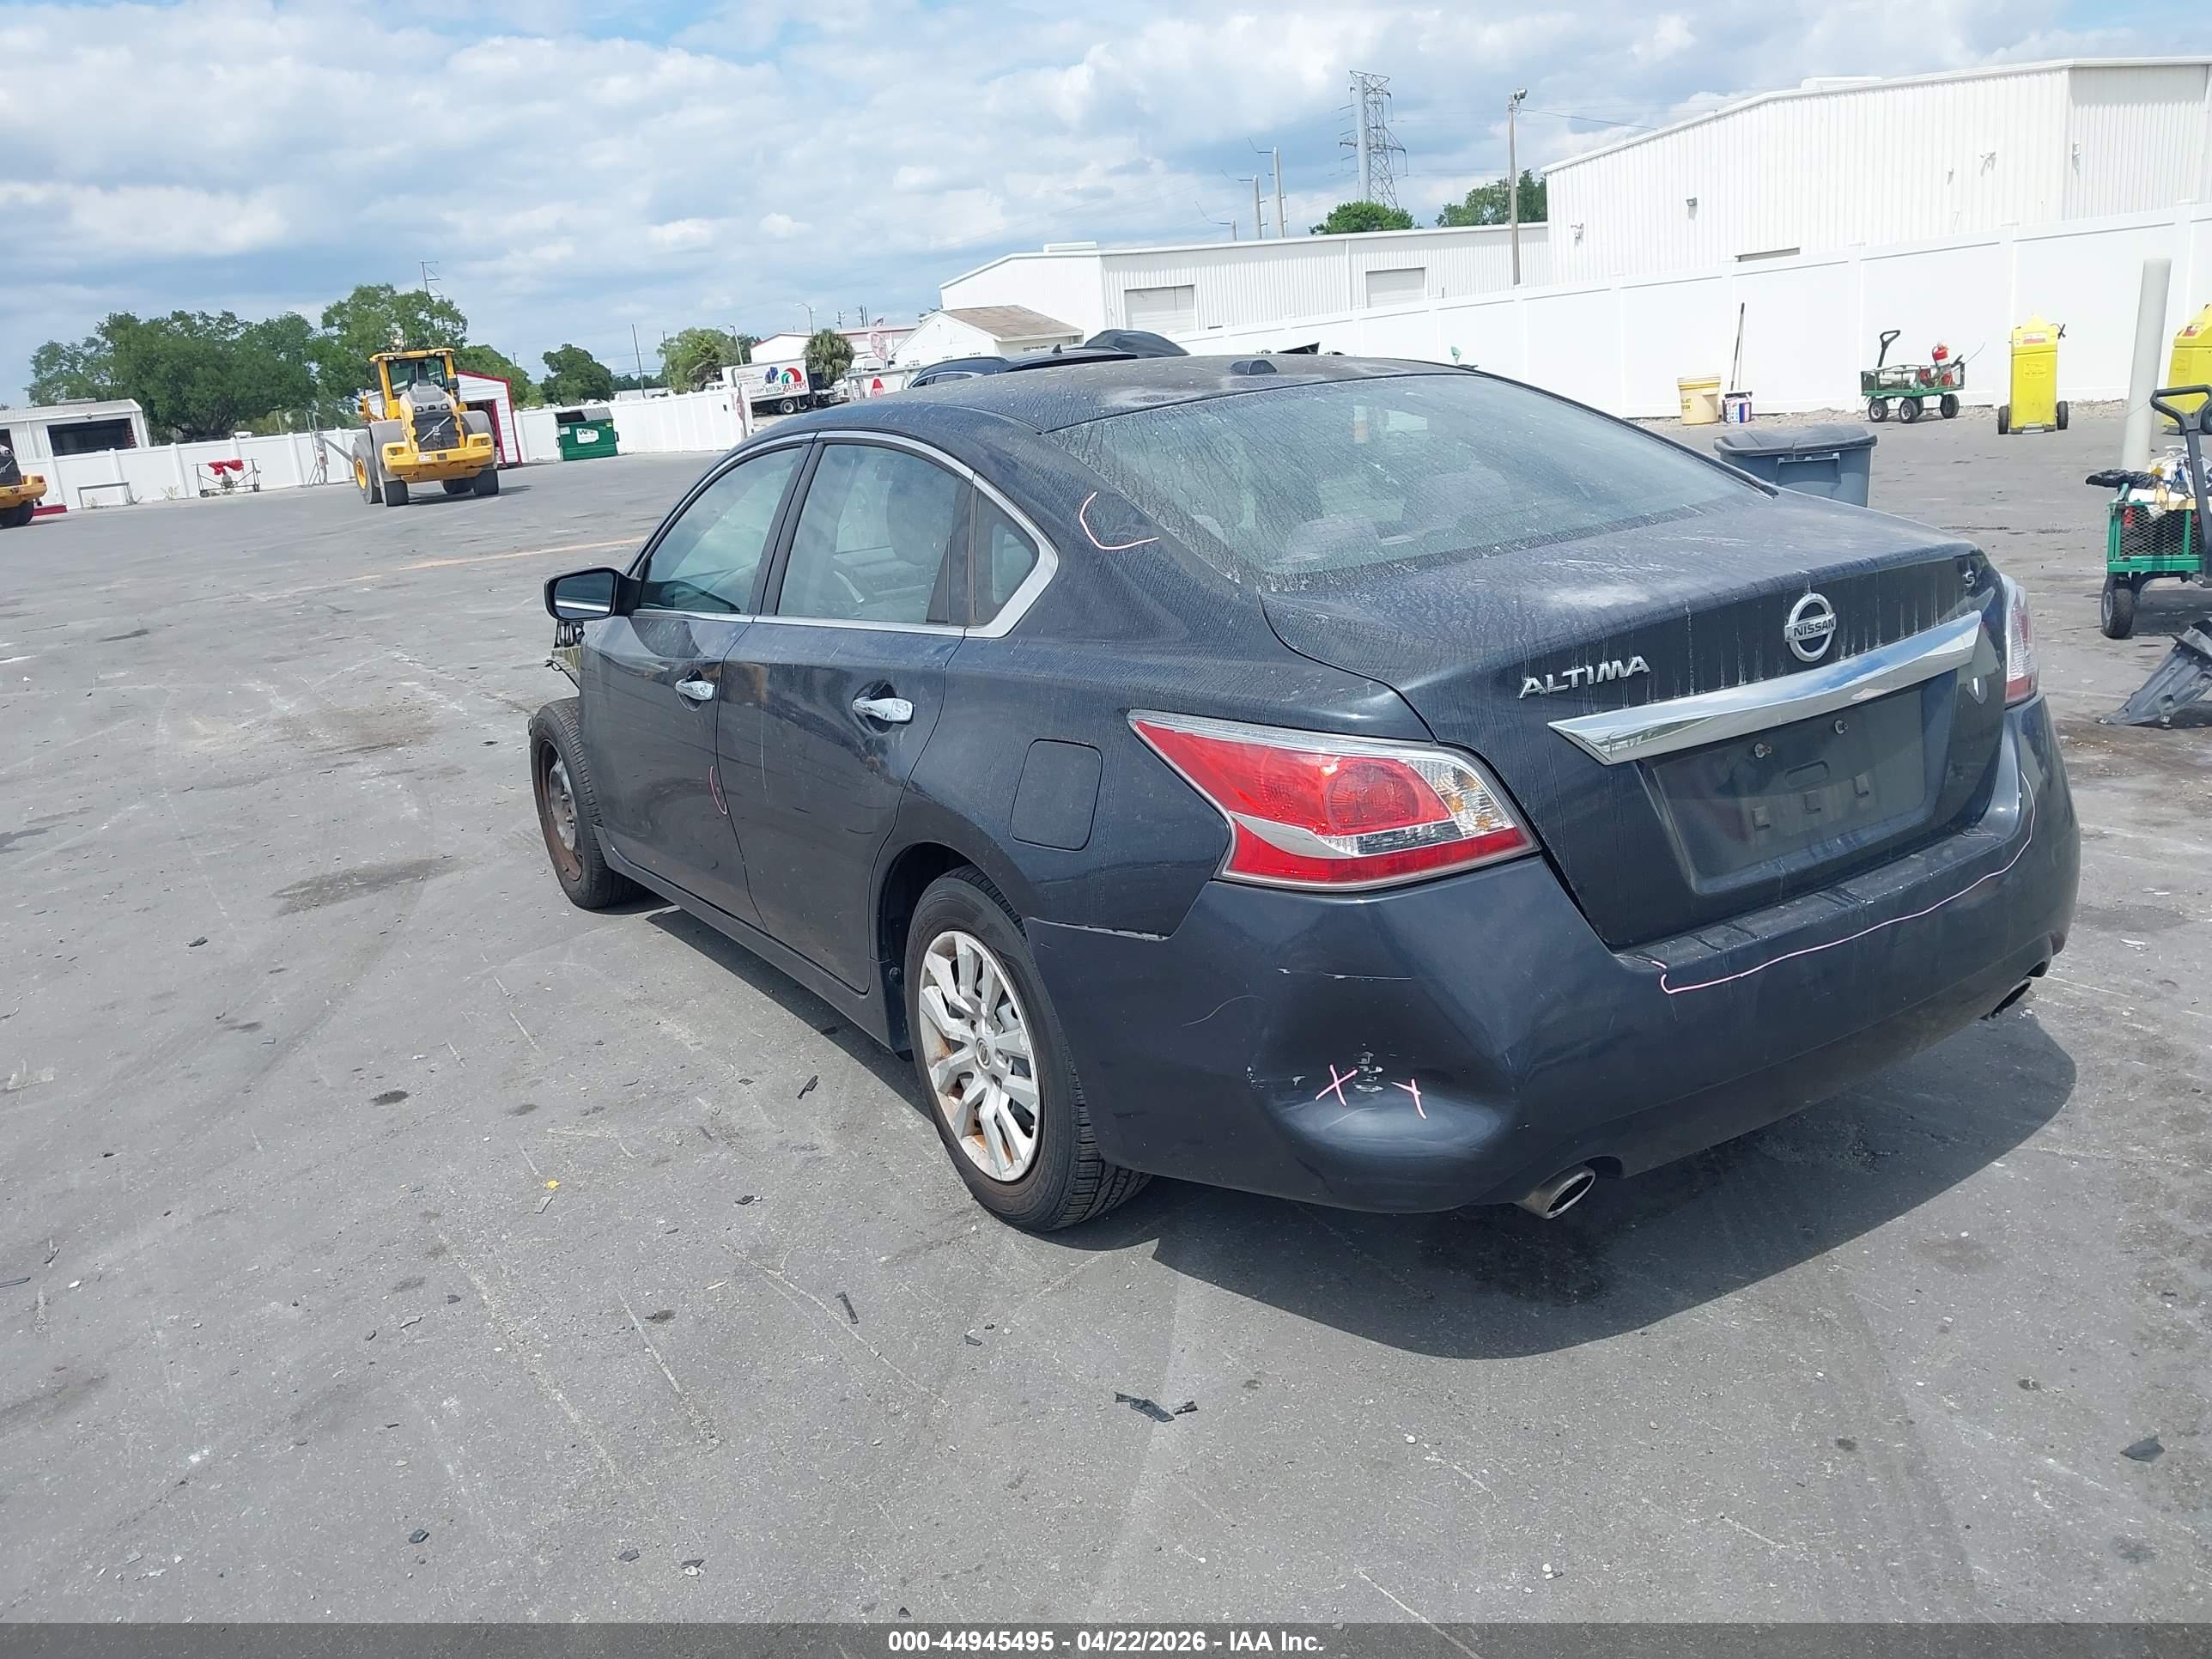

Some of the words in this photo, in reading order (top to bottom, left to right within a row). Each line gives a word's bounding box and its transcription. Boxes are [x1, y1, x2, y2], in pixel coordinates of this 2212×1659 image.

[1964, 570, 1976, 587] S
[1793, 618, 1834, 637] NISSAN
[1517, 655, 1651, 699] ALTIMA
